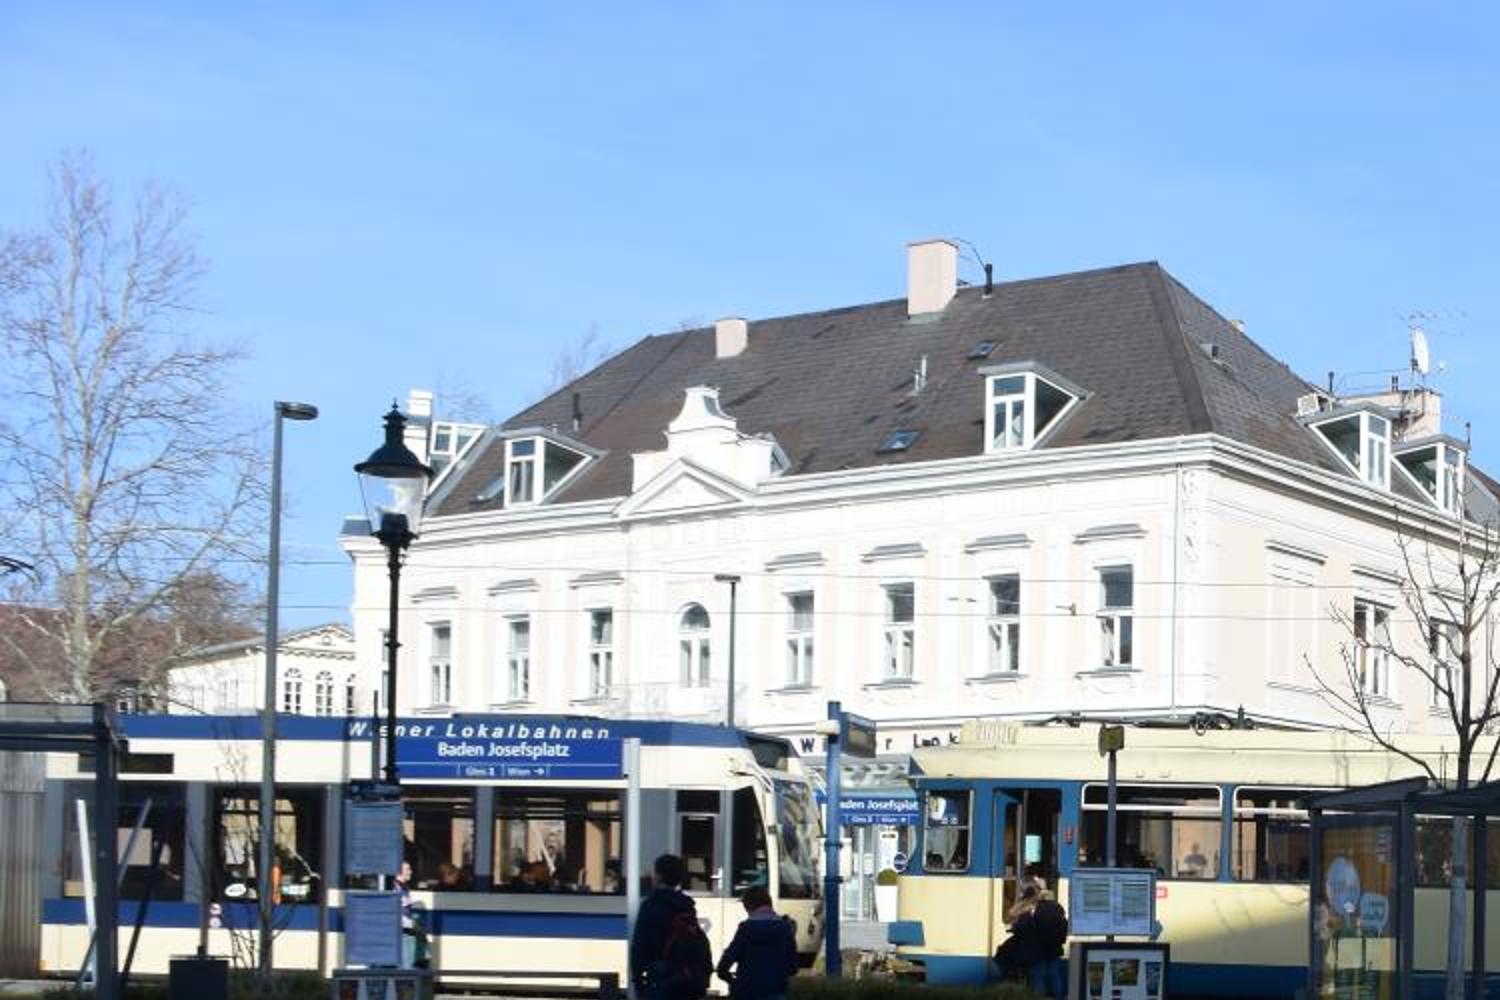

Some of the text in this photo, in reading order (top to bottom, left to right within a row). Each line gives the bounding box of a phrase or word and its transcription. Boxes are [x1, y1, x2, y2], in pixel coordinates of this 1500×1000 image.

[446, 722, 610, 739] Lokalbahnen
[438, 741, 570, 760] Baden Josefsplatz
[867, 800, 919, 812] Josefsplat
